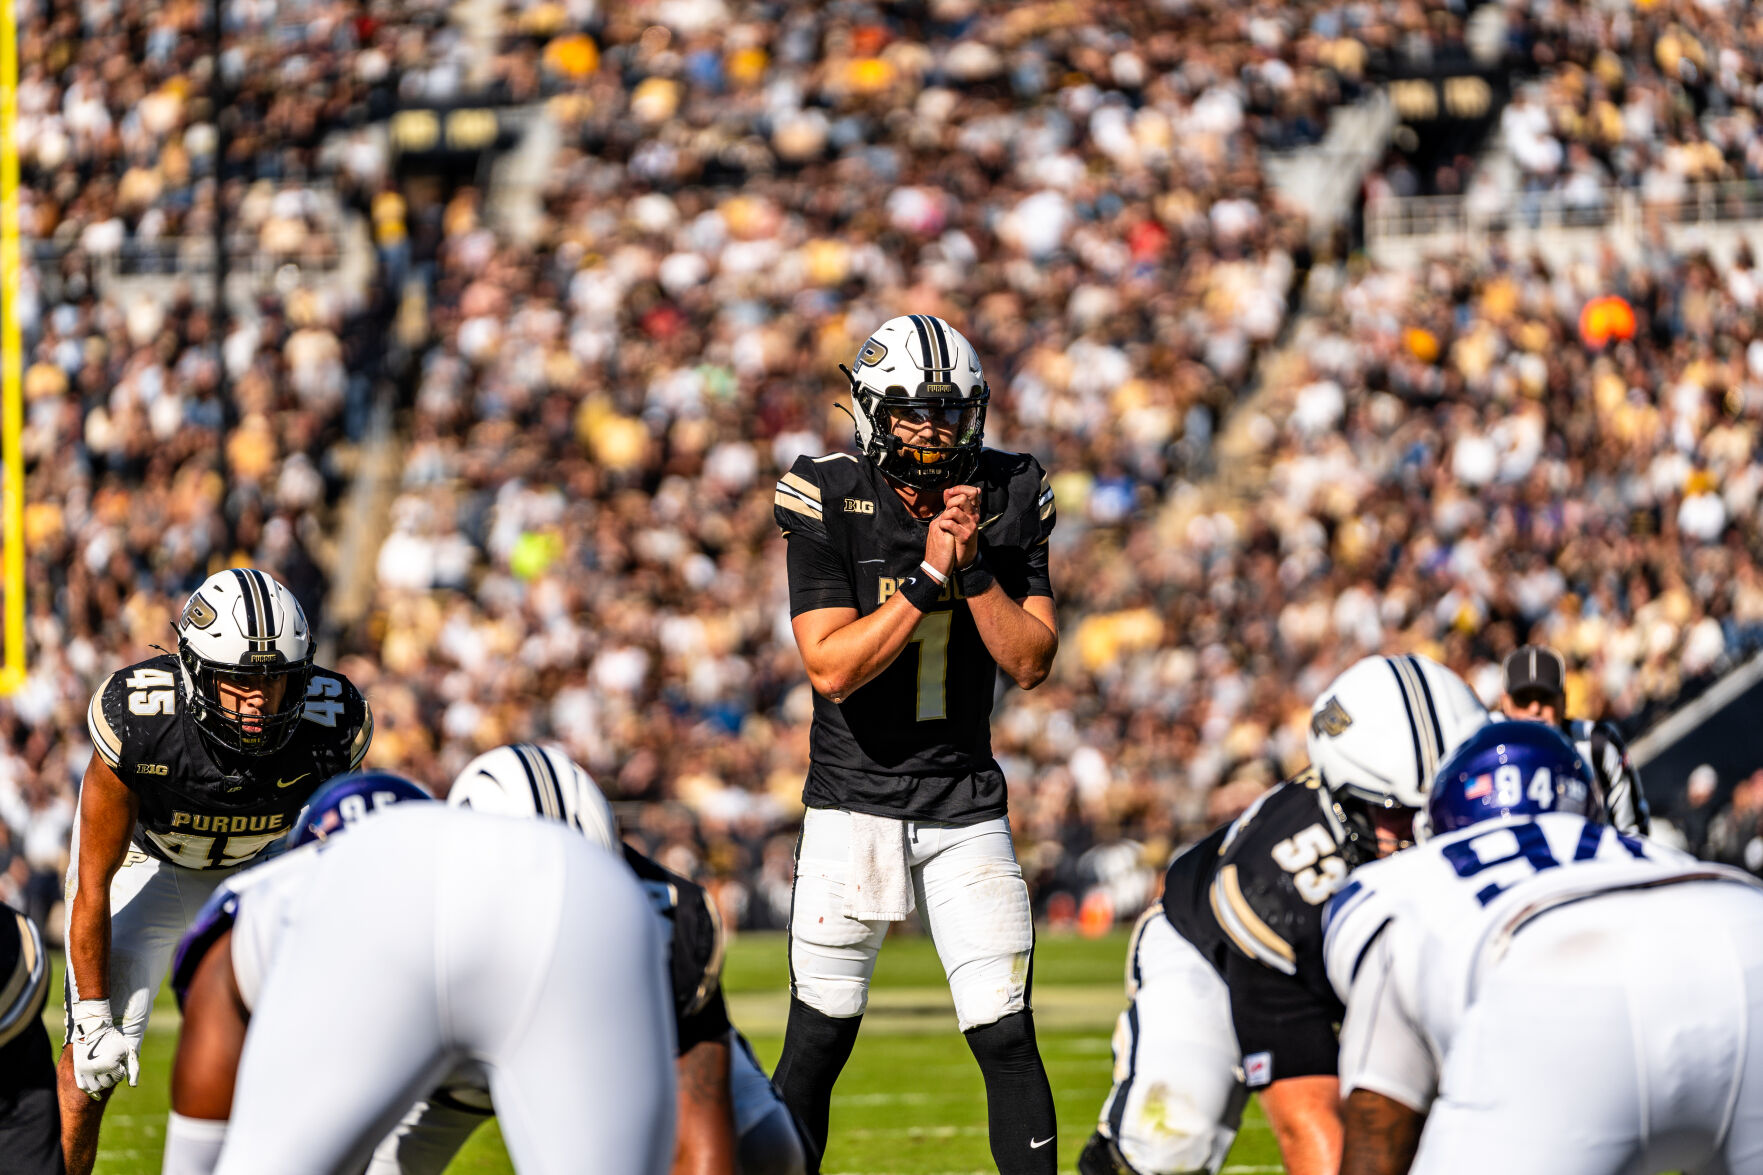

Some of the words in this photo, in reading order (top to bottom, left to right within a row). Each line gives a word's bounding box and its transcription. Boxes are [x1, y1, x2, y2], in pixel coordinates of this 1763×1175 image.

[909, 610, 953, 722] 1
[126, 668, 176, 716] 45
[302, 676, 345, 728] 45
[1494, 764, 1554, 810] 94
[172, 811, 284, 833] PURDUE
[1271, 823, 1348, 905] 53
